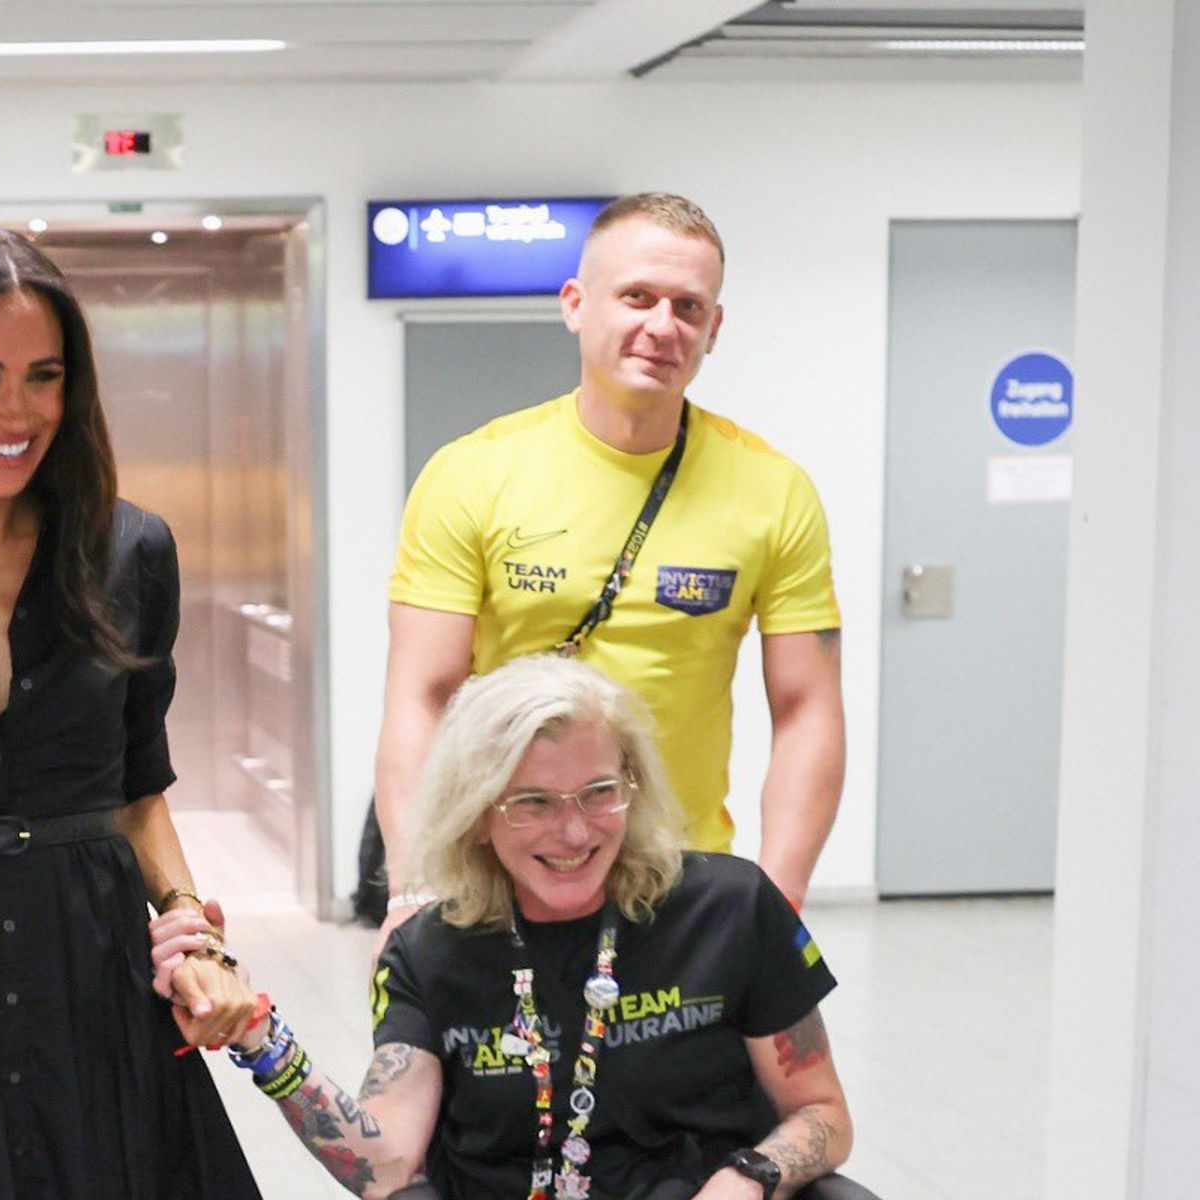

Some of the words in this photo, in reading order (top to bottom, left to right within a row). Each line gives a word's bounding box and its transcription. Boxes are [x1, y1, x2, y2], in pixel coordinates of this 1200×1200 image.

[503, 561, 567, 580] TEAM
[508, 577, 556, 594] UKR
[604, 1003, 725, 1048] UKRAINE
